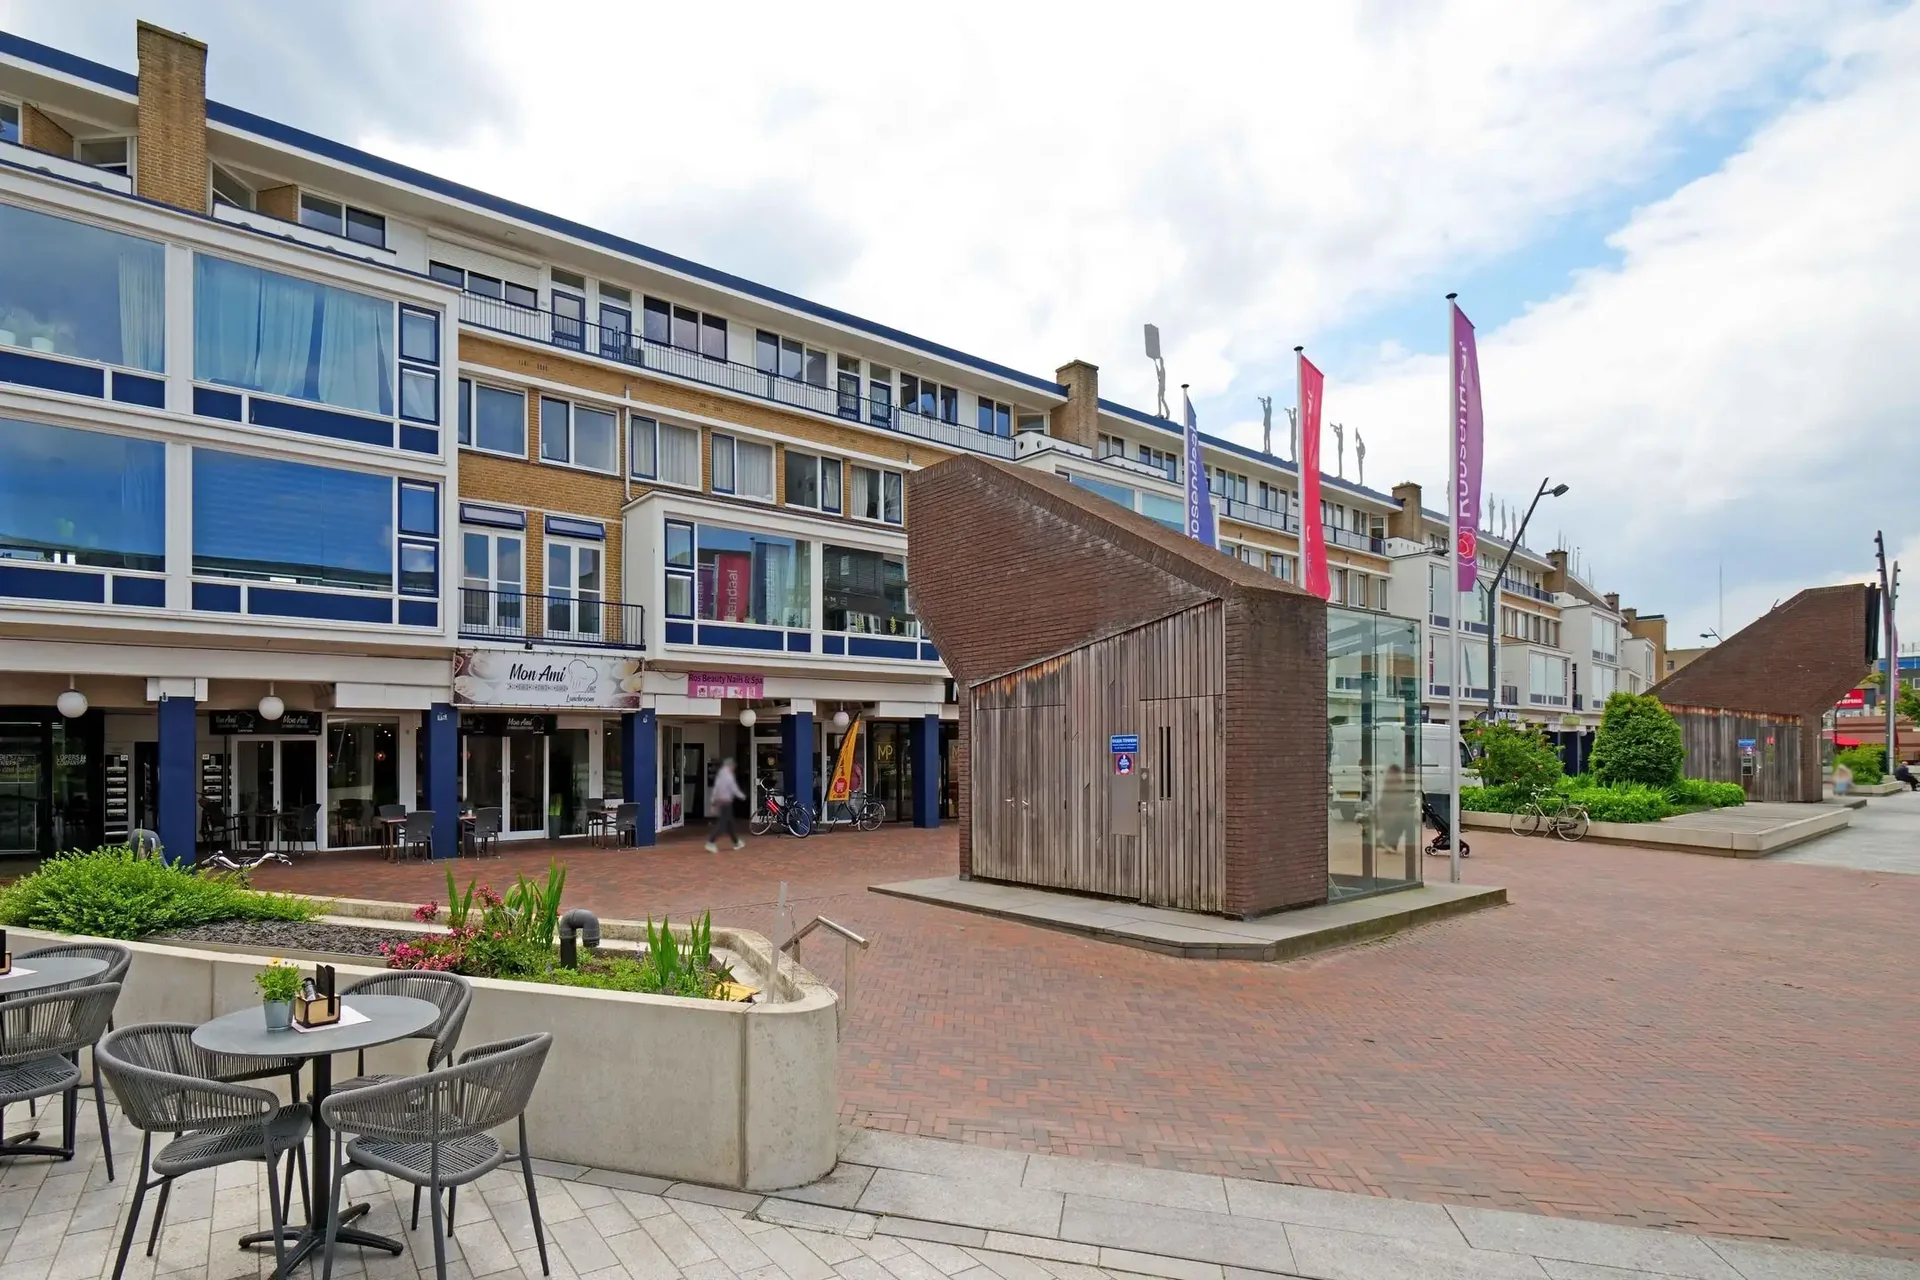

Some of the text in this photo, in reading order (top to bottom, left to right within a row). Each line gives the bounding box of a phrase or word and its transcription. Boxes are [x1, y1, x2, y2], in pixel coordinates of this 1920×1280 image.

[509, 663, 567, 682] Mon Ami
[688, 673, 763, 685] Ros Beauty Nails & Spa
[566, 694, 595, 703] Lunchroom
[507, 717, 532, 726] Mon Ami
[877, 744, 893, 760] MP
